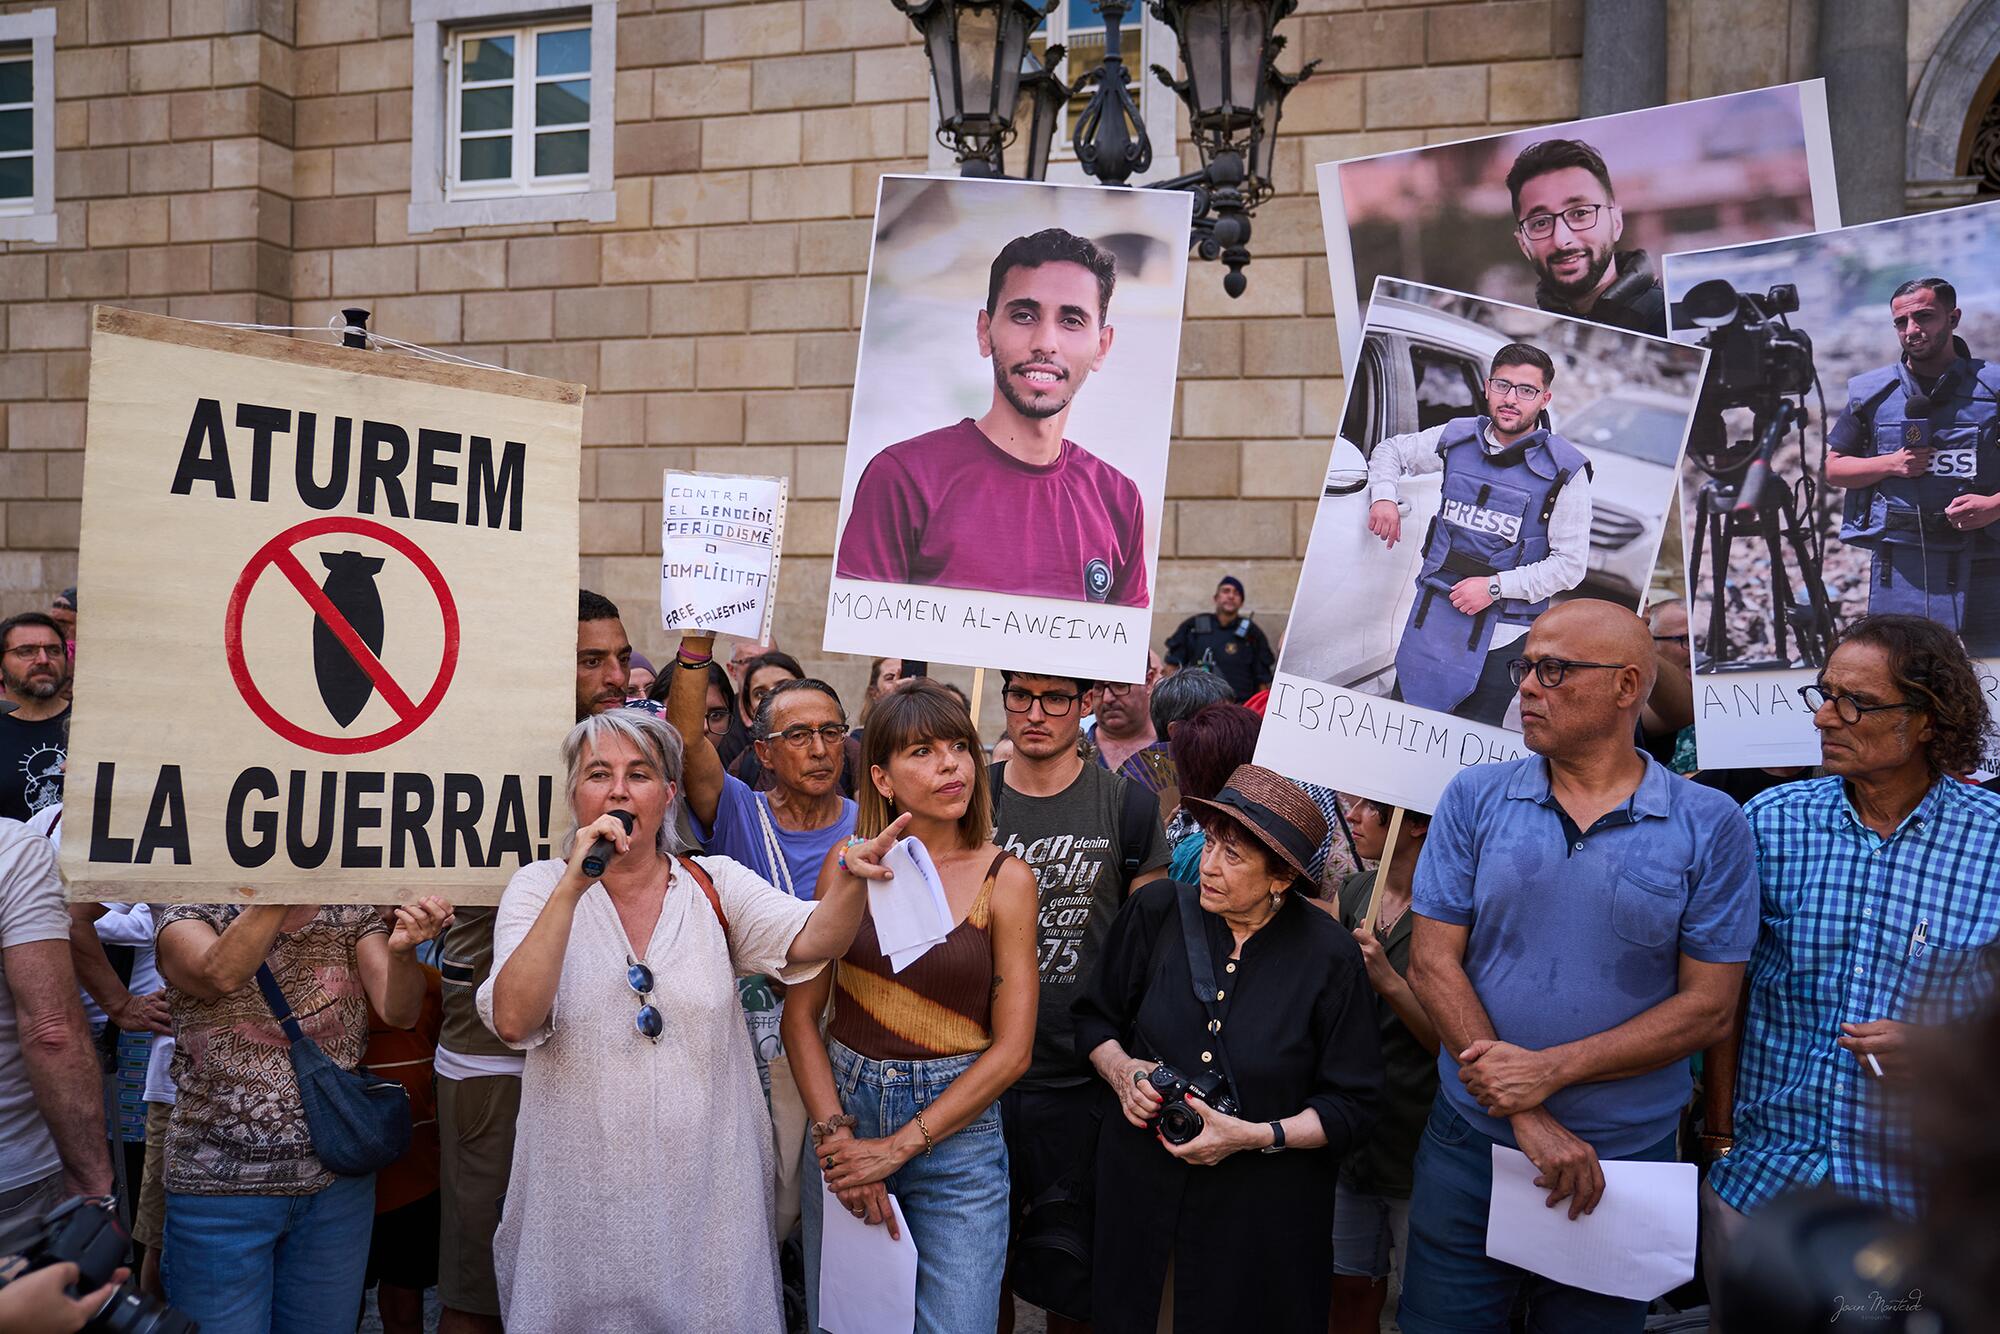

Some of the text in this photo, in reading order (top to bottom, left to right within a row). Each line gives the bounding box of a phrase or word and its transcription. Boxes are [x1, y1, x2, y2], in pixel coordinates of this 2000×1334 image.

[170, 398, 527, 532] ATUREM
[671, 487, 748, 502] CONTRA
[669, 505, 687, 516] EL
[1445, 500, 1518, 539] PRESS
[705, 543, 717, 554] O
[663, 562, 768, 587] COMPLICITAT
[665, 598, 757, 629] FREE PALESTINE
[831, 592, 1128, 645] MOAMEN AL-AWEIWA
[1702, 682, 1812, 719] ANA
[1272, 681, 1448, 759] IBRAHIM
[89, 762, 552, 870] LA GUERRA!
[1002, 834, 1110, 865] ban denim
[1037, 906, 1089, 928] ican
[1049, 894, 1094, 910] genuine
[1037, 938, 1083, 974] 75
[1188, 1084, 1206, 1098] Nikon
